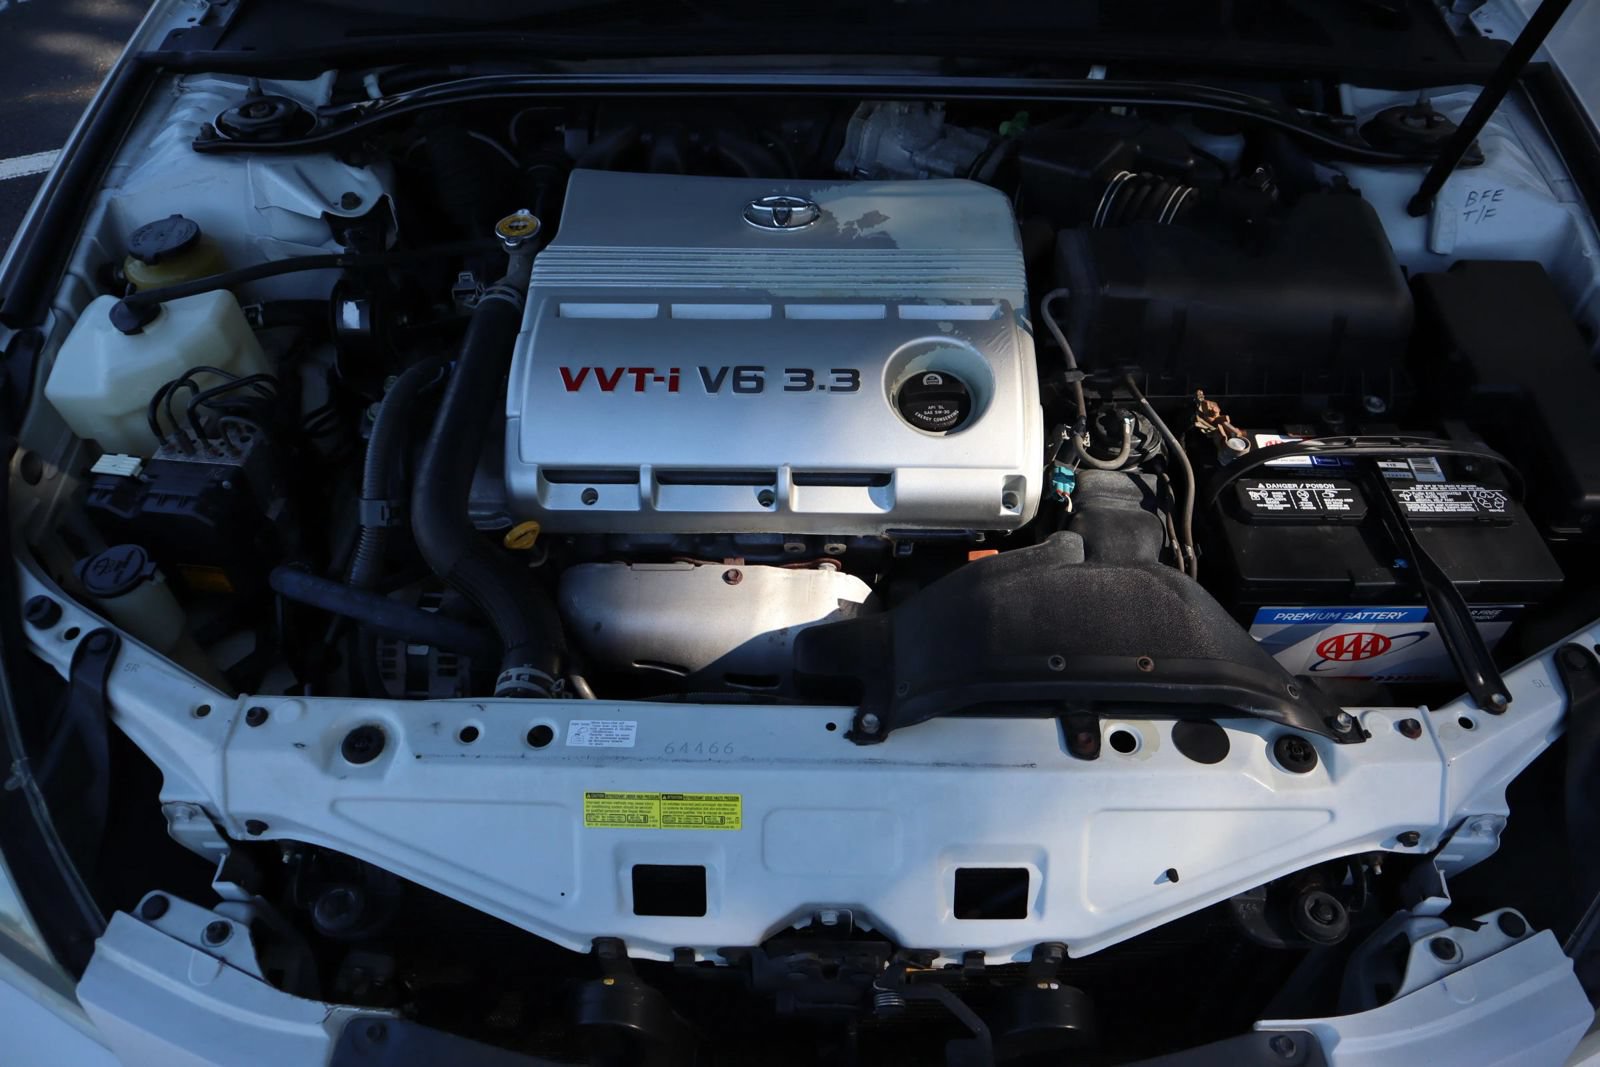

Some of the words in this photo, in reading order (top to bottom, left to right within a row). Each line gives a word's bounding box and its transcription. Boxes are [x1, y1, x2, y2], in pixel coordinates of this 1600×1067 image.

[1465, 189, 1504, 208] BFE
[559, 366, 681, 393] VVT-i
[698, 365, 766, 394] V6
[783, 367, 862, 393] 3.3
[914, 411, 932, 422] ENERGY
[1273, 612, 1342, 621] PREMIUM
[1343, 611, 1408, 620] BATTERY
[1322, 634, 1385, 660] AAA
